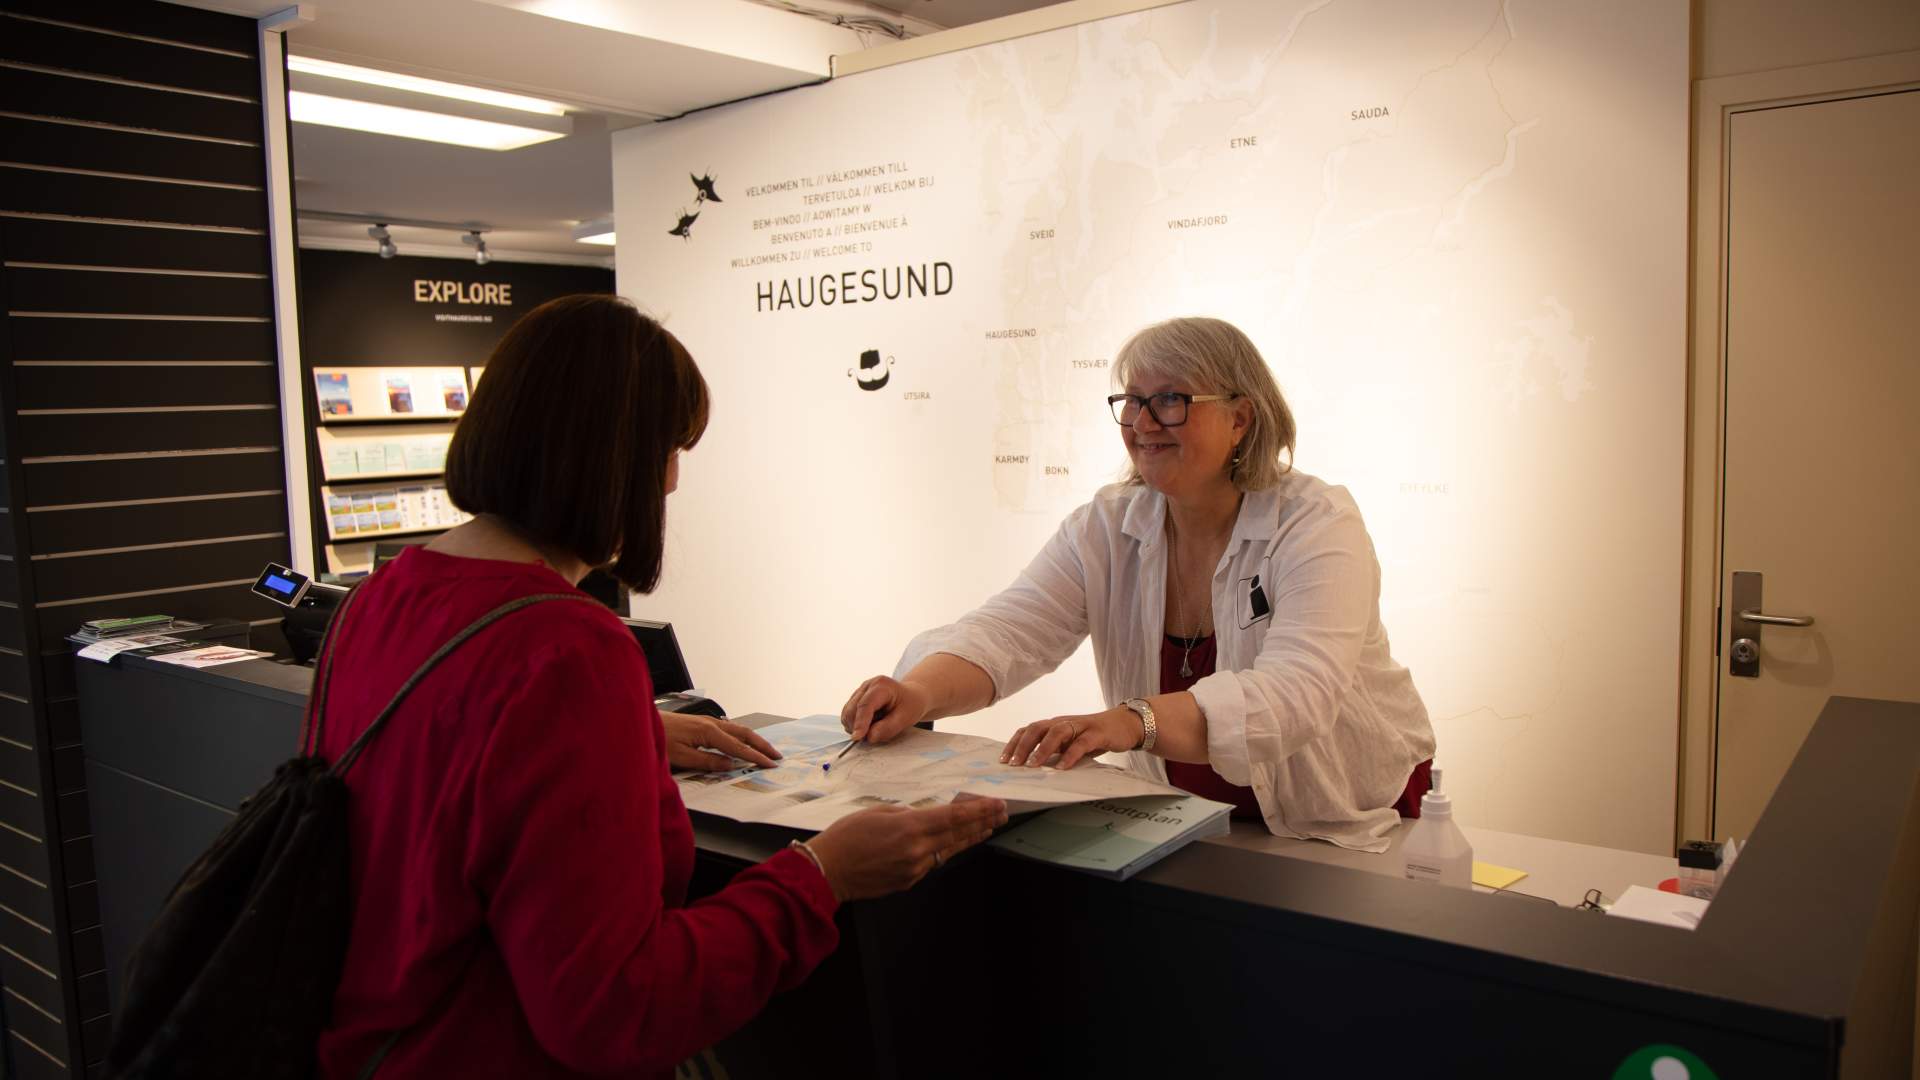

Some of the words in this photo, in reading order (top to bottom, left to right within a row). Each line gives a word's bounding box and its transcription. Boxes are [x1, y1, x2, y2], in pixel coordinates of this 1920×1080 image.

[1351, 105, 1391, 120] SAUDA
[1229, 136, 1257, 149] ETNE
[745, 180, 799, 198] VELKOMMEN
[801, 177, 814, 189] TIL
[888, 161, 909, 174] TILL
[803, 187, 861, 206] TERVETULOA
[873, 179, 916, 195] WELKOM
[919, 175, 935, 188] BIJ
[863, 203, 872, 214] W
[1167, 215, 1229, 230] VINDAFJORD
[770, 228, 824, 245] BENVENUTO
[826, 227, 833, 237] A
[844, 217, 899, 235] BIENVENUE
[1029, 228, 1055, 240] SVEIO
[730, 252, 788, 269] WILLKOMMEN
[790, 250, 801, 262] ZU
[813, 242, 857, 258] WELCOME
[859, 241, 873, 252] TO
[413, 279, 512, 305] EXPLORE
[757, 260, 954, 313] HAUGESUND
[985, 327, 1037, 340] HAUGESUND
[1071, 358, 1108, 369] TYSVÆR
[903, 391, 931, 400] UTSIRA
[995, 454, 1030, 465] KARMØY
[1044, 464, 1069, 476] BOKN
